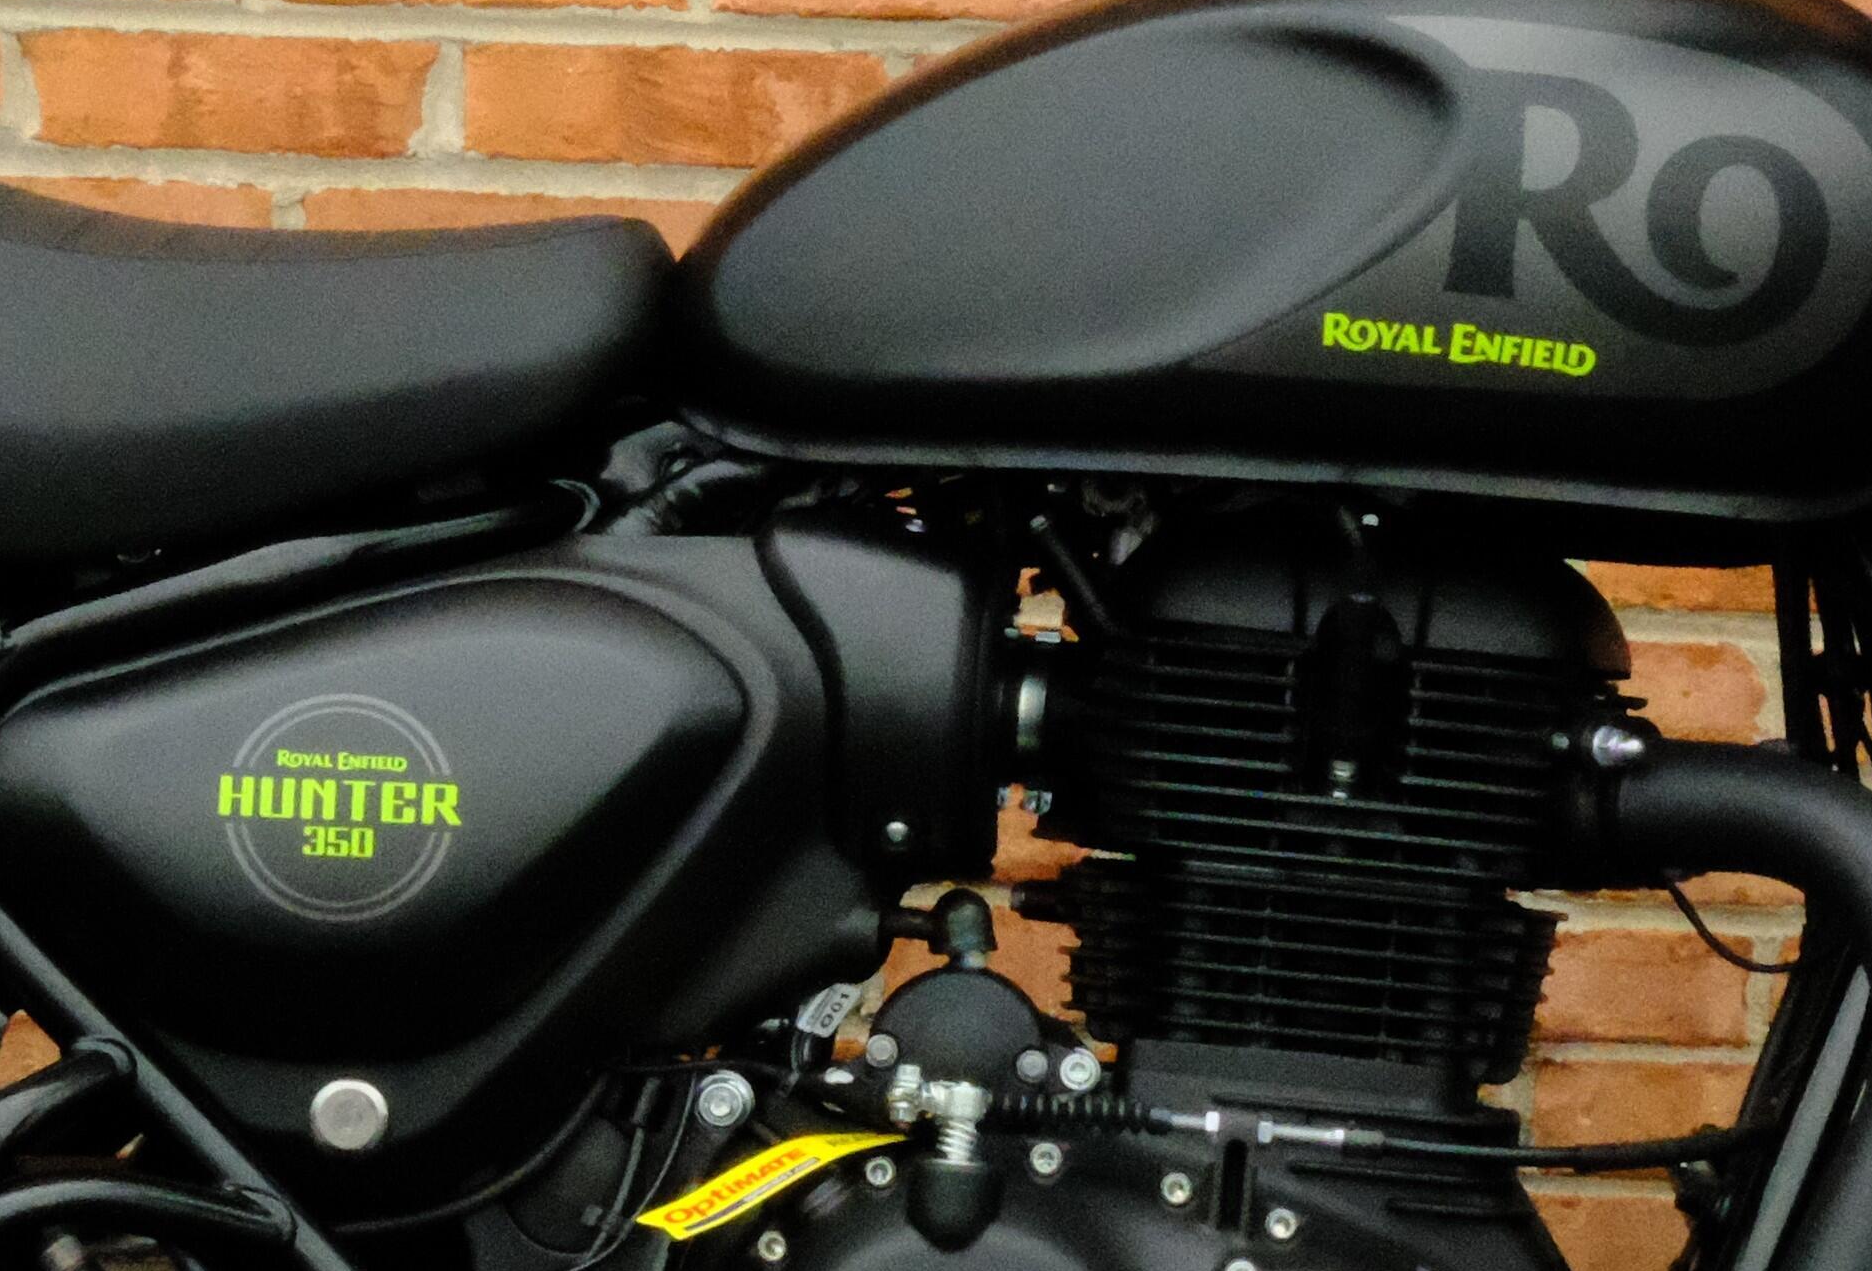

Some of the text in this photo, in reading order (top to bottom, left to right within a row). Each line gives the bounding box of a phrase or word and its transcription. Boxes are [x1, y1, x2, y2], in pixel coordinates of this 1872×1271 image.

[1321, 312, 1597, 378] ROYAL ENFIELD
[276, 749, 408, 773] ROYAL ENFIELD
[217, 774, 462, 826] HUNTER
[301, 826, 375, 858] 350
[664, 1147, 807, 1224] OptiMATE
